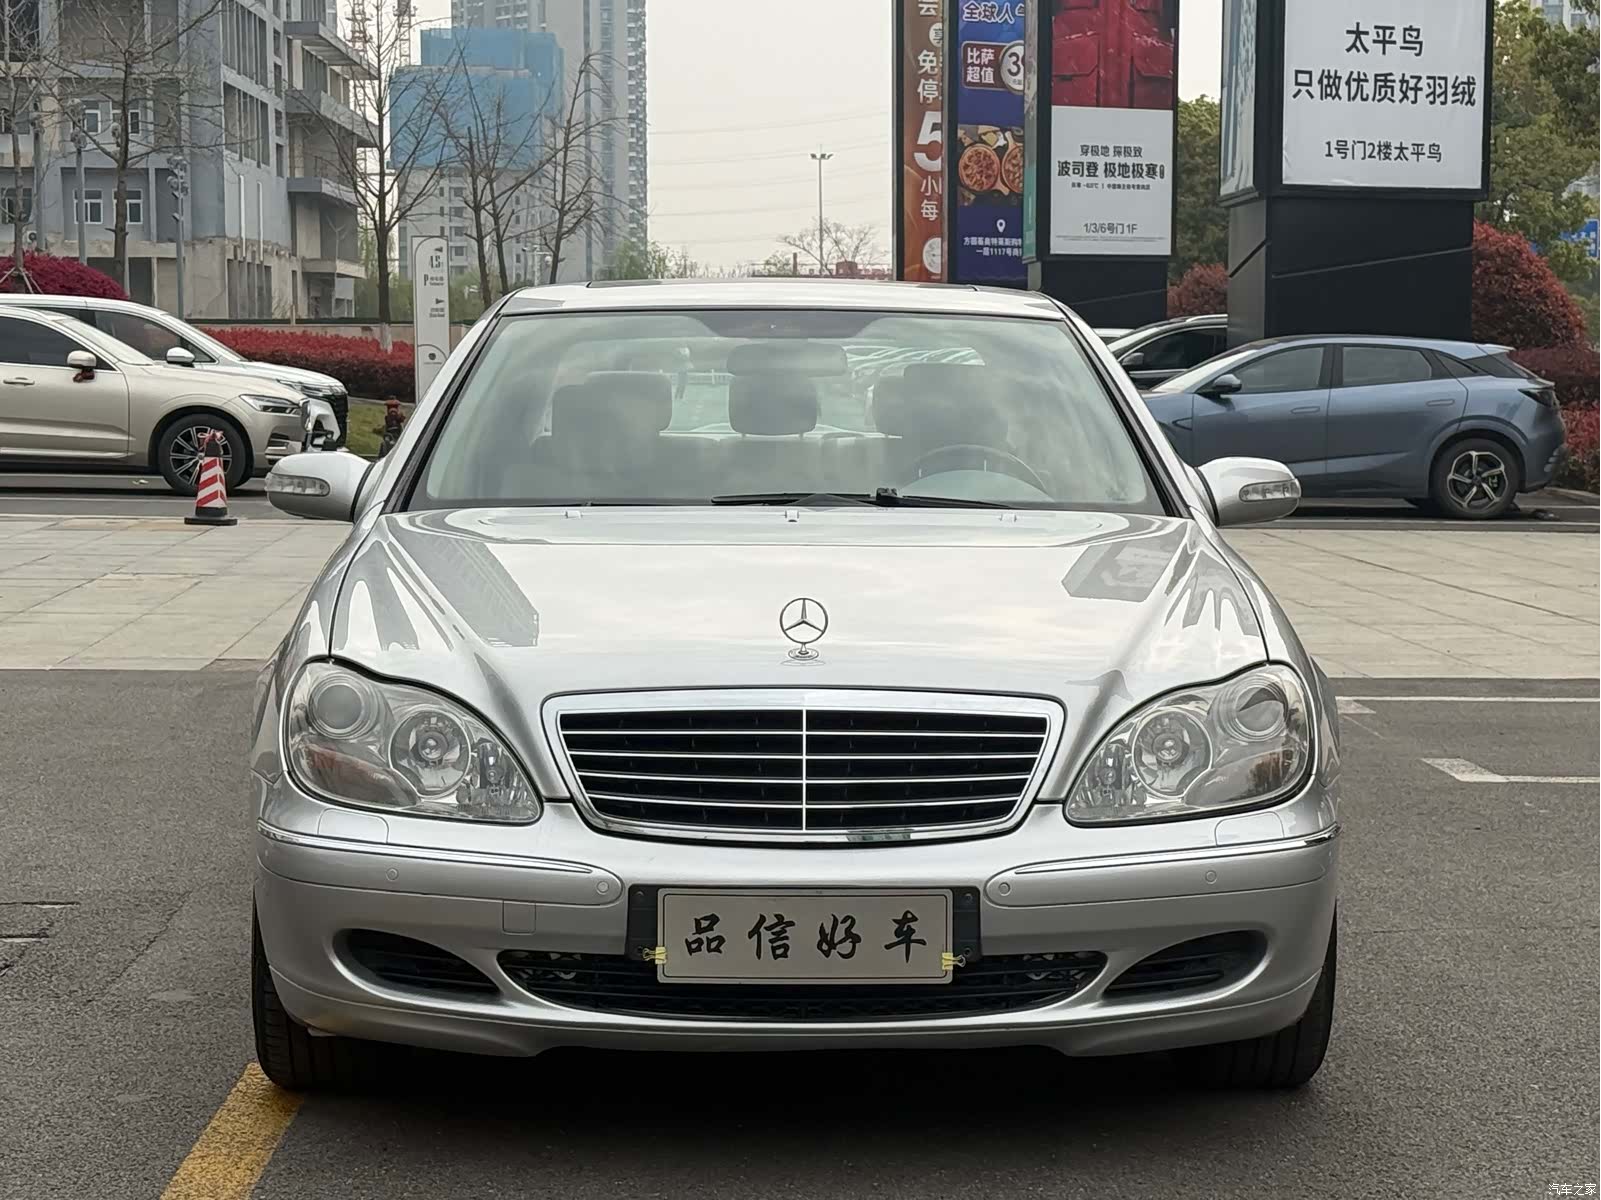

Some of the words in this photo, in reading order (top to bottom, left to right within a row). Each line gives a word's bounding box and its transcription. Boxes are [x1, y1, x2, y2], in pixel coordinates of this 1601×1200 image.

[1345, 22, 1424, 56] 太平鸟
[967, 47, 995, 65] 比萨
[1007, 51, 1025, 77] 3
[966, 65, 995, 84] 超值
[1292, 69, 1477, 107] 只做优质好羽绒
[1324, 140, 1443, 163] 1号门2楼太平鸟
[1057, 160, 1099, 178] 波司登
[1103, 161, 1158, 180] 极地极寒
[920, 199, 939, 221] 每
[685, 910, 927, 963] 品信好车
